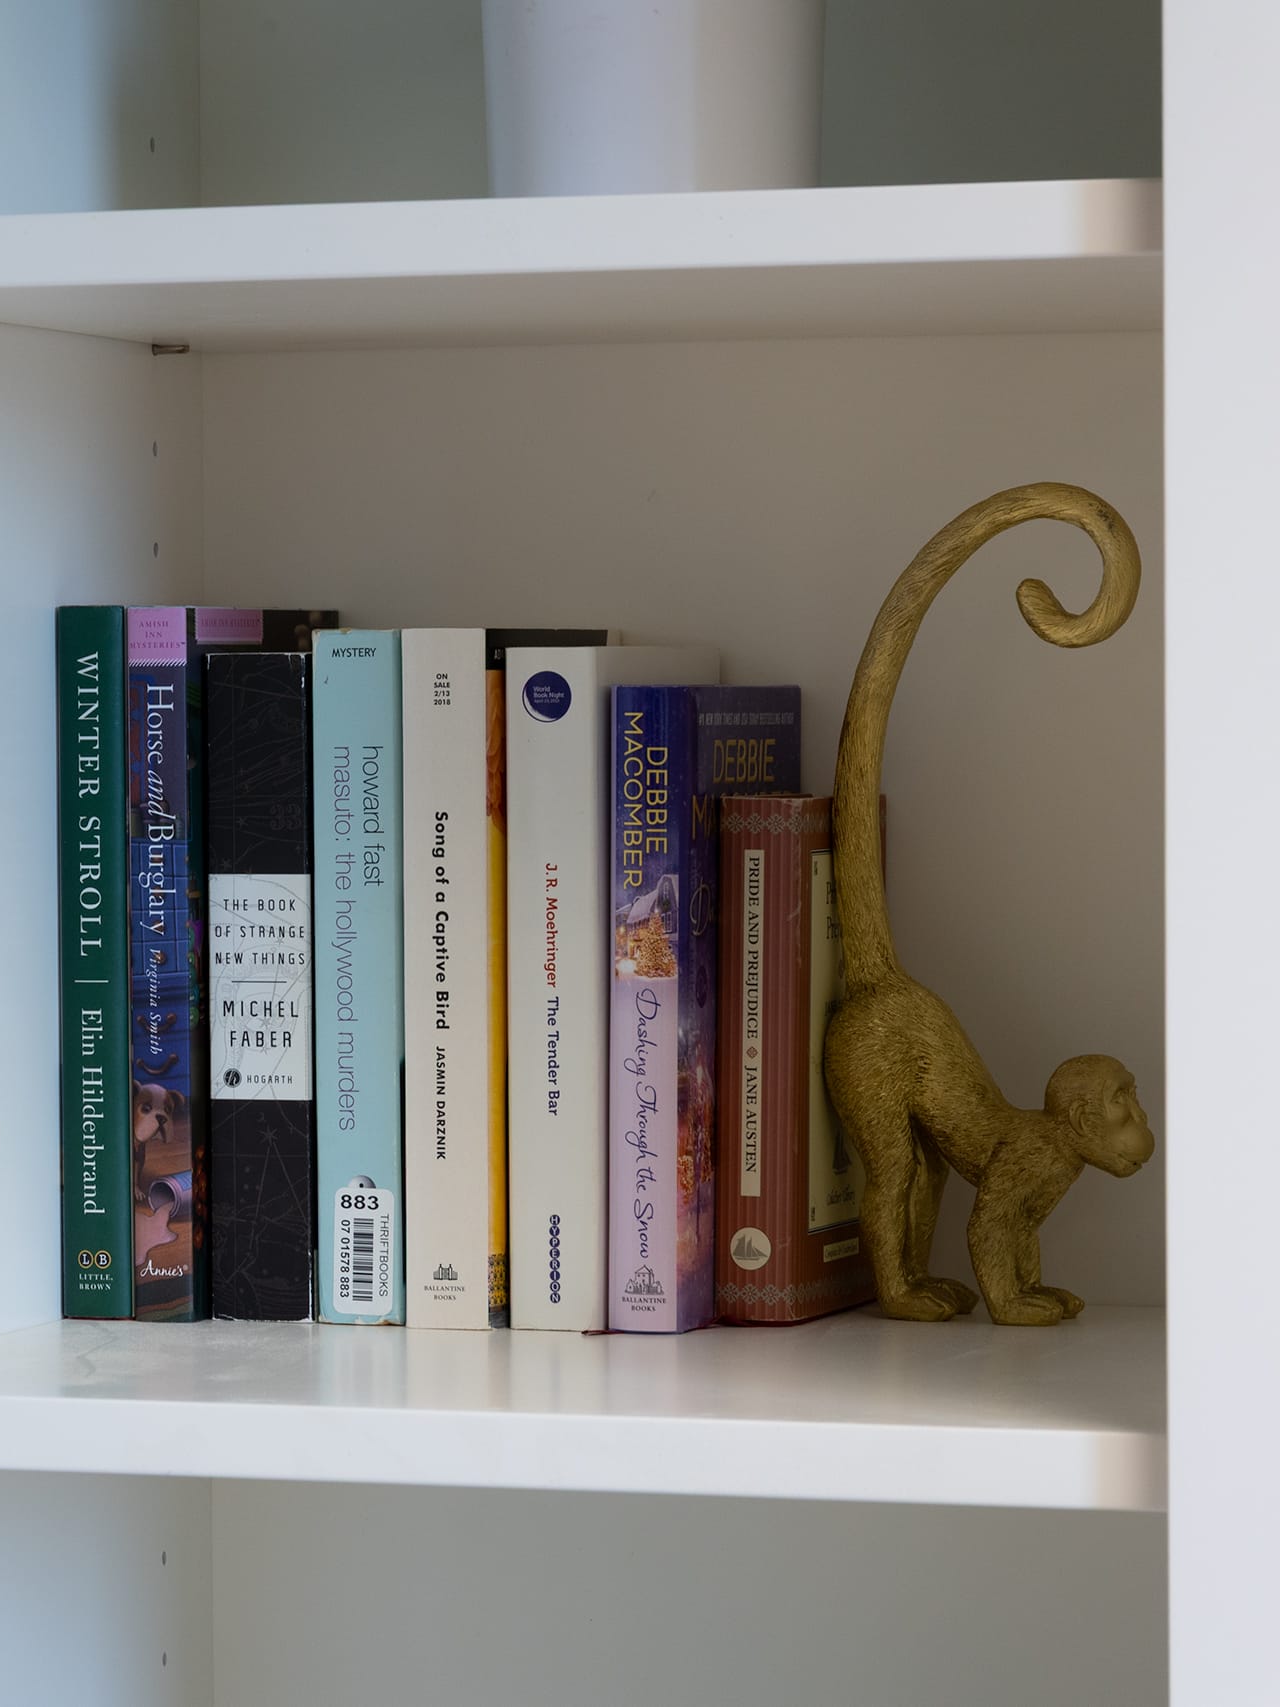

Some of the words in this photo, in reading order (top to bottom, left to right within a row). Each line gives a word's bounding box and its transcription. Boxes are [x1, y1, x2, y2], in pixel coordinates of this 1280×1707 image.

[138, 620, 169, 629] AMISH
[145, 631, 163, 639] INN
[331, 647, 377, 658] MYSTERY
[433, 681, 451, 689] SALE
[433, 698, 451, 706] 2018
[76, 651, 100, 799] WINTER
[146, 684, 174, 765] Horse
[712, 738, 776, 784] DEBBIE
[147, 770, 176, 820] and
[333, 746, 355, 841] masuto:
[362, 746, 385, 834] howard
[623, 711, 644, 890] MACOMBER
[646, 746, 668, 855] DEBBIE
[432, 811, 449, 859] Song
[78, 815, 102, 957] STROLL
[138, 824, 176, 936] Burglary
[335, 851, 357, 890] the
[363, 842, 386, 887] fast
[435, 866, 450, 885] of
[748, 856, 760, 907] PRIDE
[223, 899, 249, 912] THE
[257, 899, 297, 912] BOOK
[435, 891, 445, 903] a
[214, 925, 232, 938] OF
[240, 925, 305, 938] STRANGE
[432, 911, 449, 983] Captive
[544, 897, 559, 988] Moehringer
[748, 911, 759, 946] AND
[145, 948, 162, 1008] Virginia
[215, 952, 244, 965] NEW
[252, 952, 305, 965] THINGS
[331, 899, 359, 1022] hollywood
[222, 1000, 299, 1018] MICHEL
[435, 991, 450, 1030] Bird
[546, 996, 559, 1026] The
[746, 950, 759, 1039] PREJUDICE
[81, 1008, 103, 1056] Elin
[148, 1011, 163, 1055] Smith
[230, 1030, 293, 1048] FABER
[623, 987, 661, 1077] Dashing
[246, 1074, 293, 1085] HOGARTH
[436, 1046, 446, 1096] JASMIN
[547, 1030, 560, 1086] Tender
[337, 1032, 360, 1131] murders
[548, 1090, 560, 1116] Bar
[744, 1064, 757, 1105] JANE
[82, 1067, 105, 1215] Hilderbrand
[436, 1101, 446, 1160] DARZNIK
[624, 1081, 658, 1163] Through
[745, 1109, 757, 1173] AUSTEN
[340, 1194, 380, 1210] 883
[636, 1167, 657, 1193] the
[340, 1219, 351, 1235] 07
[633, 1197, 654, 1259] Snow
[339, 1237, 350, 1274] 01578
[378, 1213, 390, 1297] THRIFTBOOKS
[549, 1214, 561, 1304] HYPERION
[79, 1283, 112, 1291] BROWN
[339, 1276, 350, 1298] 883
[621, 1296, 667, 1304] BALLANTINE
